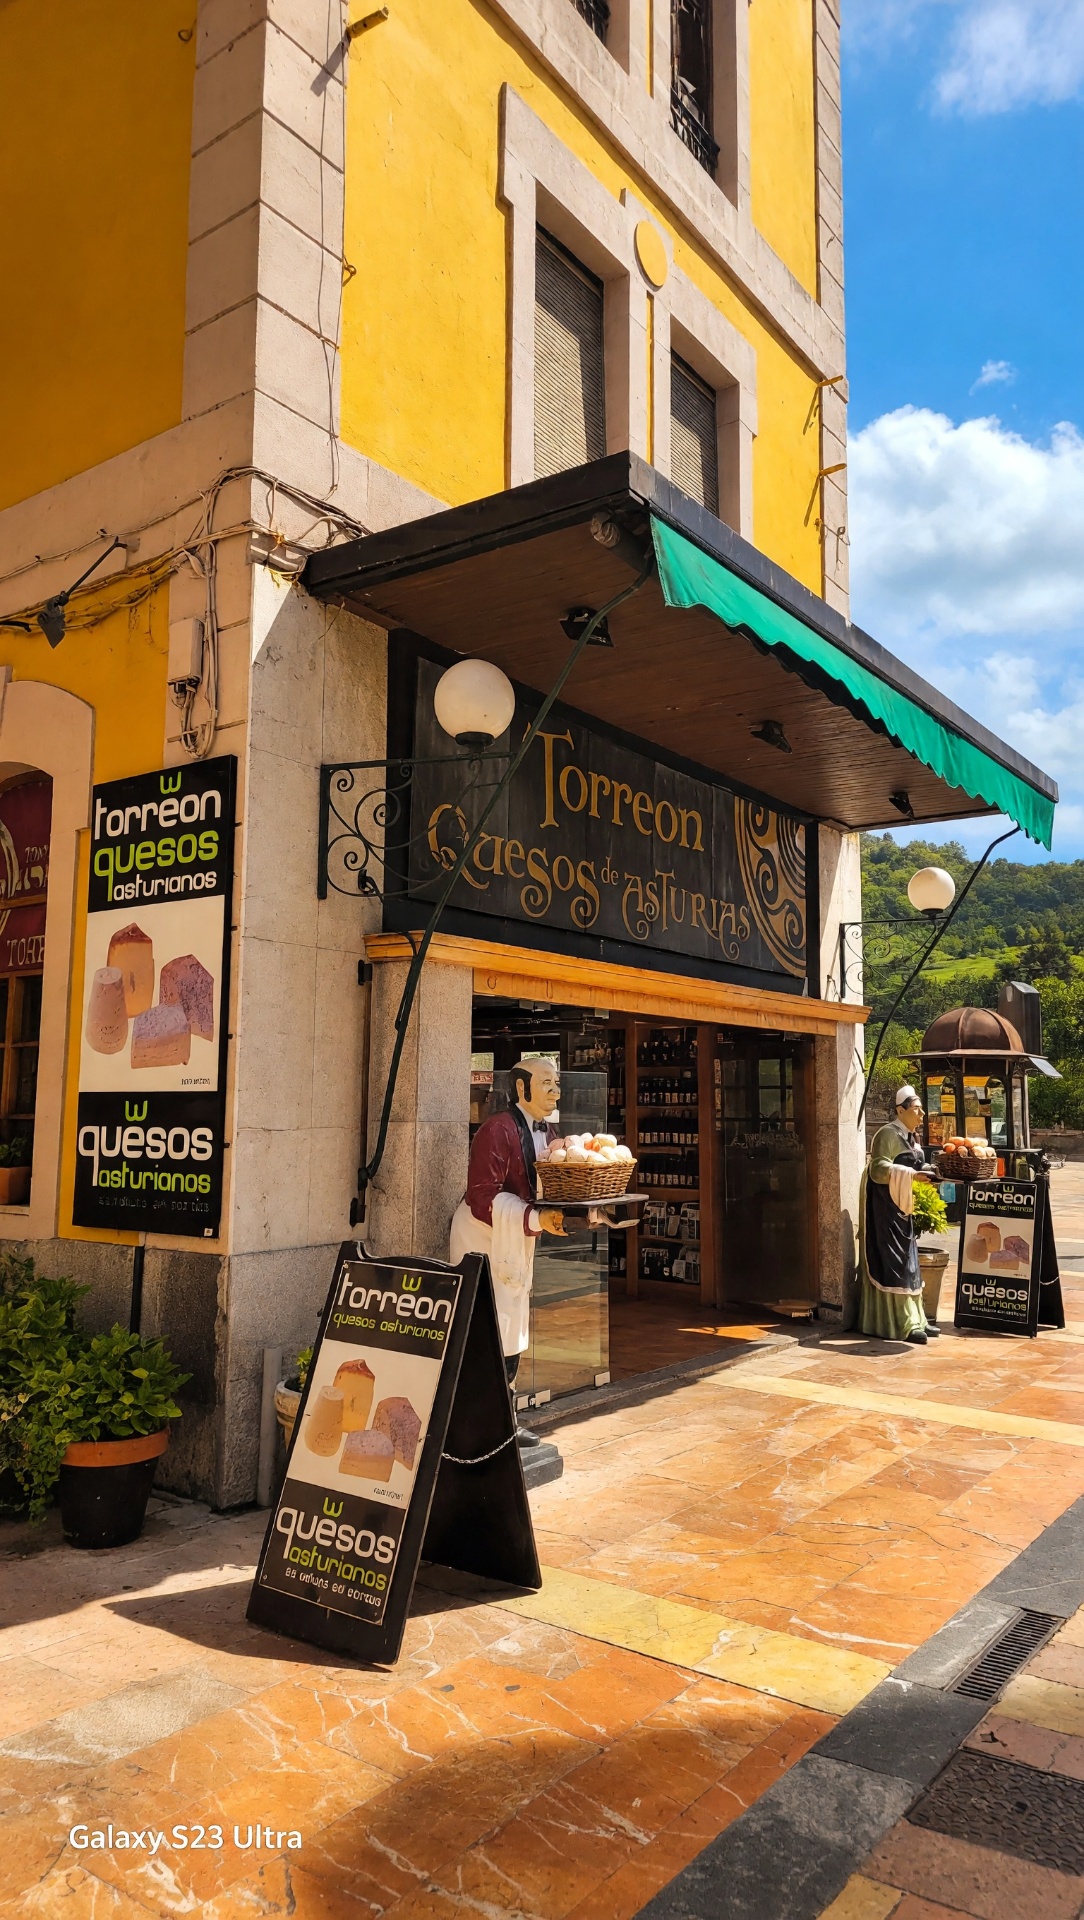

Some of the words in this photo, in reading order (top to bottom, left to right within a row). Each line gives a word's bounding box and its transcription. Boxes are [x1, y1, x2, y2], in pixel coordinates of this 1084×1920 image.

[522, 722, 704, 852] Torreon
[94, 790, 221, 840] torreon
[94, 830, 219, 902] quesos
[113, 871, 217, 901] asturianos
[428, 803, 600, 928] Quesos
[601, 856, 619, 885] de
[78, 1125, 213, 1187] quesos
[98, 1161, 211, 1193] asturianos
[969, 1185, 1034, 1205] torreon
[337, 1272, 452, 1323] torreon
[961, 1283, 1028, 1305] quesos
[333, 1312, 376, 1329] quesos
[380, 1319, 445, 1340] asturianos
[276, 1506, 395, 1564] quesos
[288, 1546, 387, 1591] asturianos
